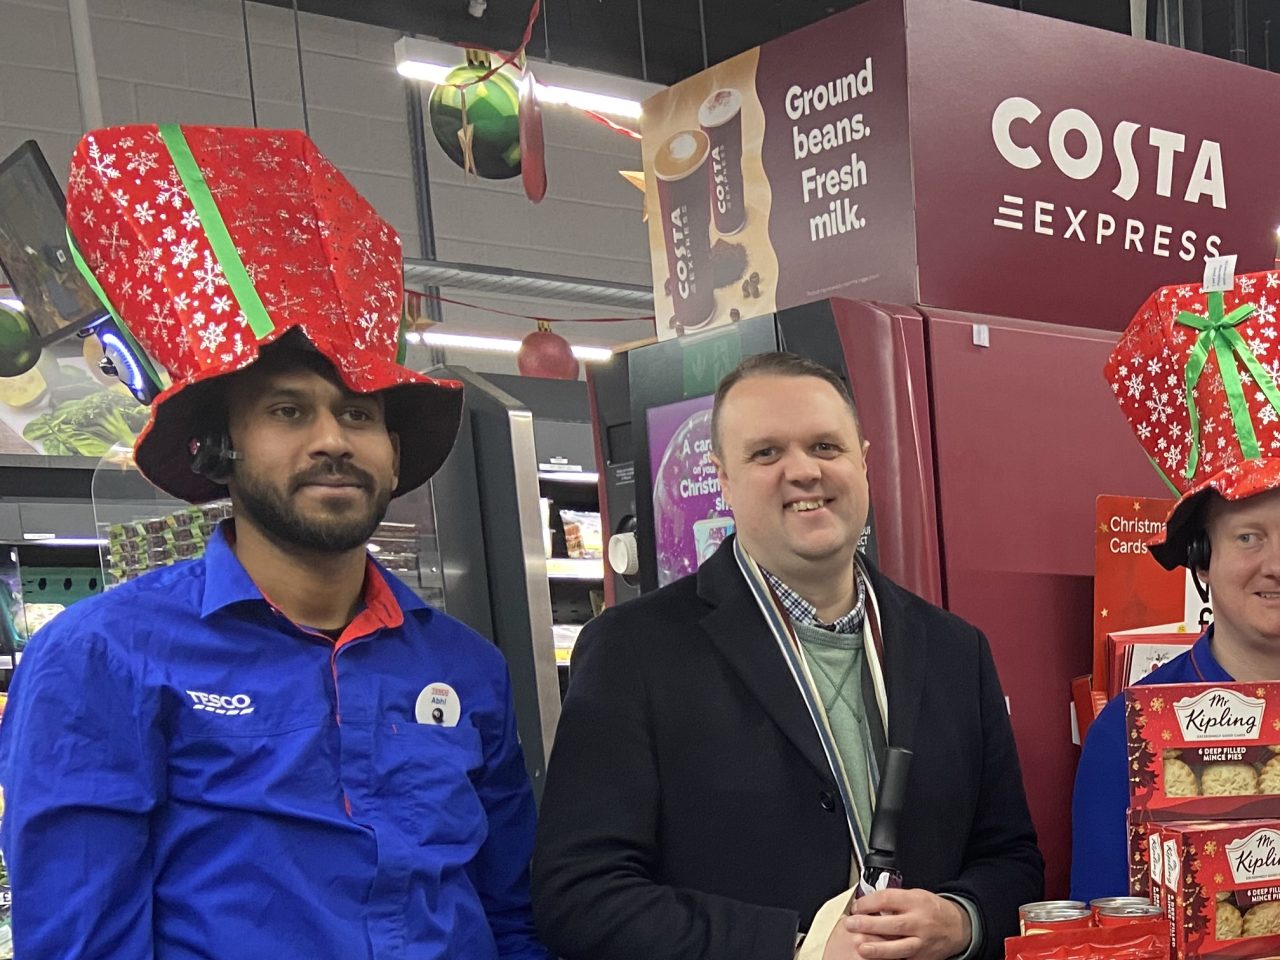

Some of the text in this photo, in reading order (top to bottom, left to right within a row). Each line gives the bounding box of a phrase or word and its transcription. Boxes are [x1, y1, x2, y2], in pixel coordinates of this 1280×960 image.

[785, 58, 873, 120] Ground
[793, 113, 870, 160] beans.
[992, 97, 1226, 209] COSTA
[711, 145, 727, 214] COSTA
[802, 153, 867, 203] Fresh
[810, 198, 866, 241] milk.
[1034, 201, 1222, 262] EXPRESS
[670, 206, 689, 299] COSTA
[683, 439, 691, 454] A
[702, 465, 716, 477] you
[1110, 516, 1167, 534] Christma
[1110, 537, 1148, 554] Cards
[186, 690, 252, 709] TESCO
[1208, 694, 1230, 708] Mr
[1184, 707, 1257, 734] Kipling
[1203, 753, 1243, 762] MINCE PIES
[1204, 747, 1222, 755] DEEP
[1223, 746, 1247, 755] FILLED
[1256, 834, 1275, 848] Mr
[1251, 894, 1271, 902] MINCE
[1252, 888, 1268, 897] DEEP
